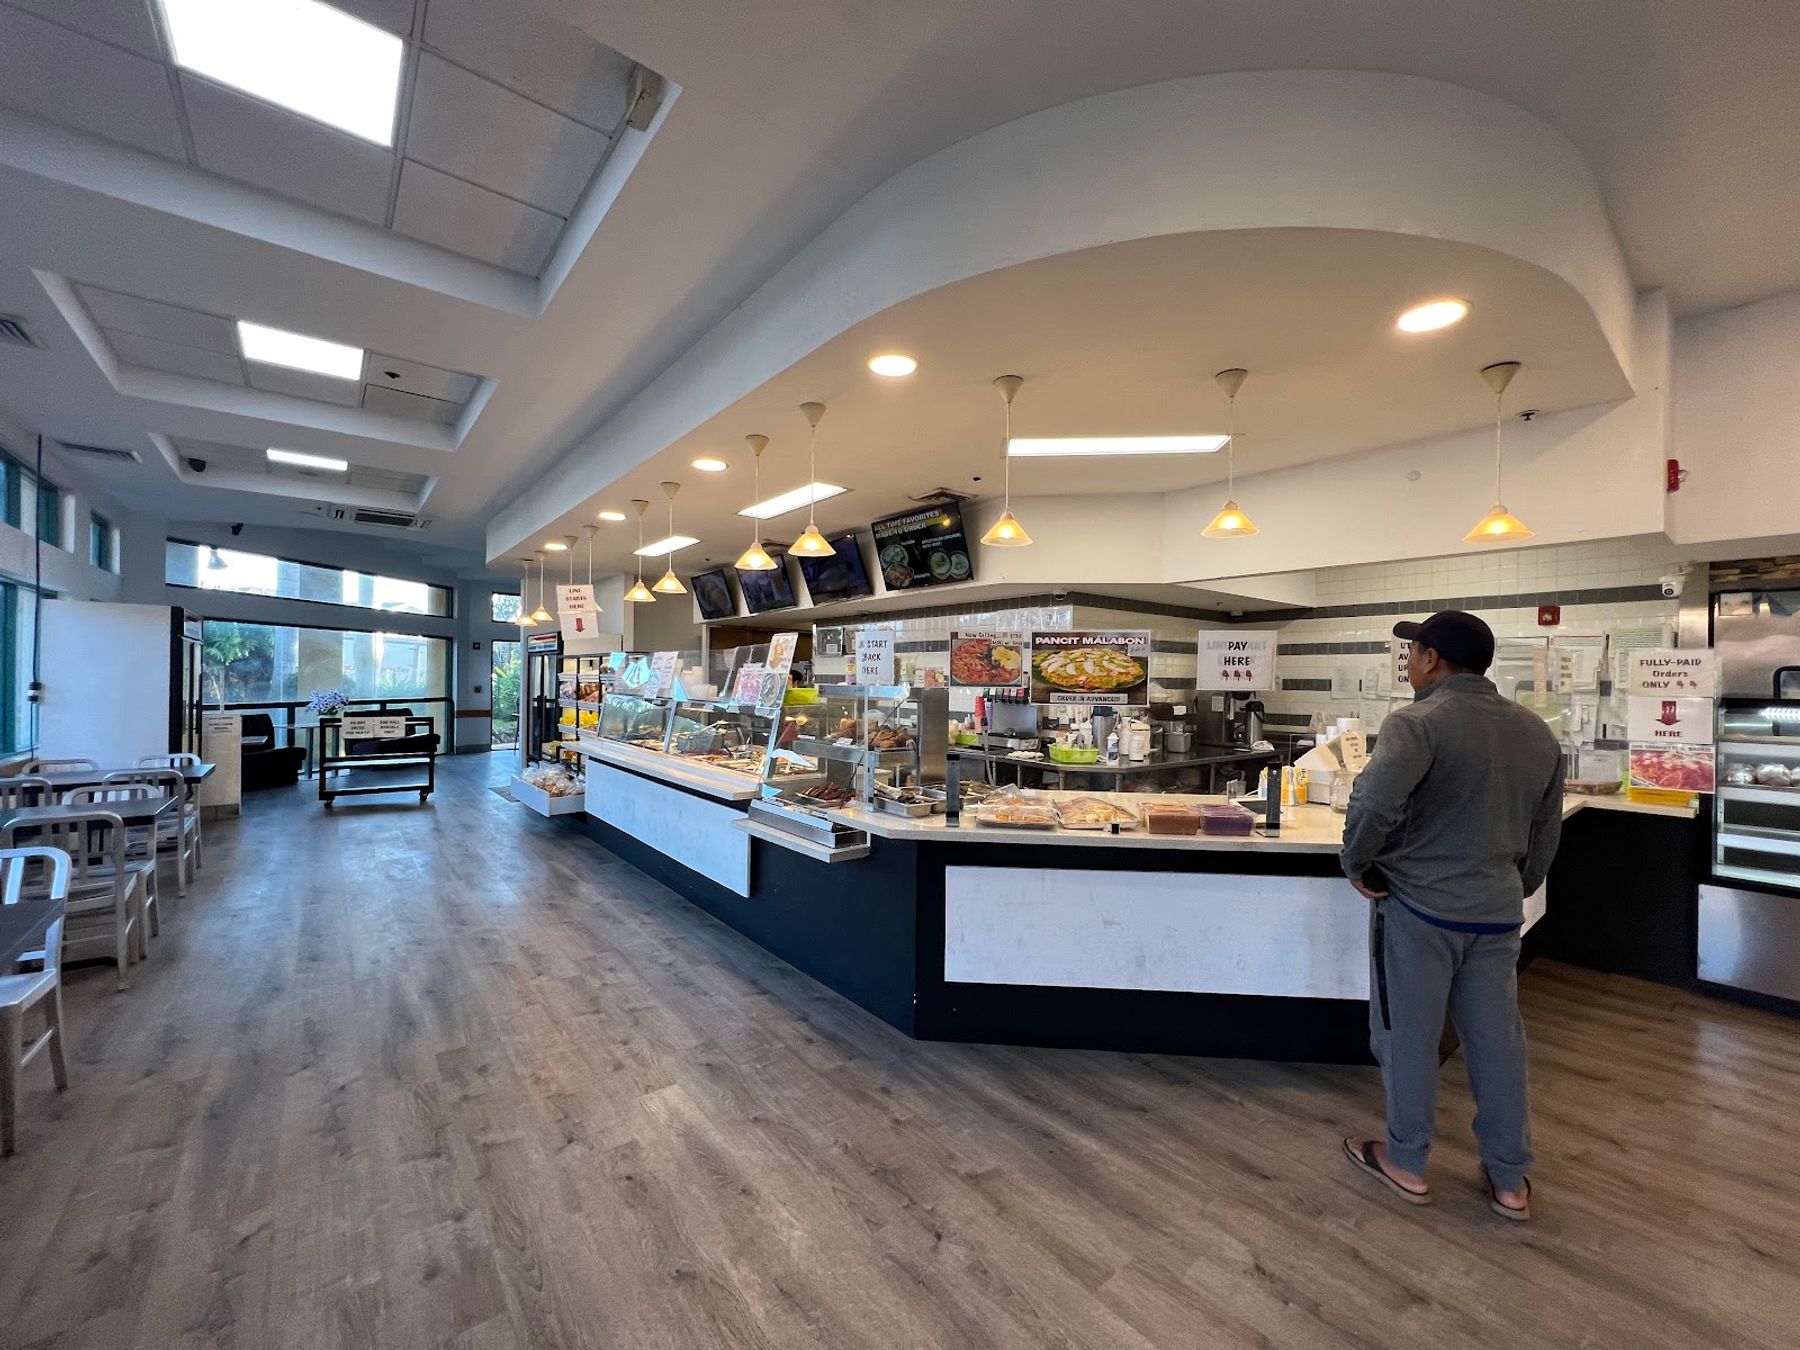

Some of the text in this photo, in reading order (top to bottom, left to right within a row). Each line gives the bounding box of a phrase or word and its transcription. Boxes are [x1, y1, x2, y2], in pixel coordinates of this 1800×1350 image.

[887, 520, 901, 528] TIME
[902, 510, 940, 524] FAVORITES
[867, 640, 887, 648] START
[1082, 636, 1145, 645] MALABON
[1228, 641, 1248, 651] PAY
[863, 653, 881, 662] BACK
[1224, 656, 1251, 666] HERE
